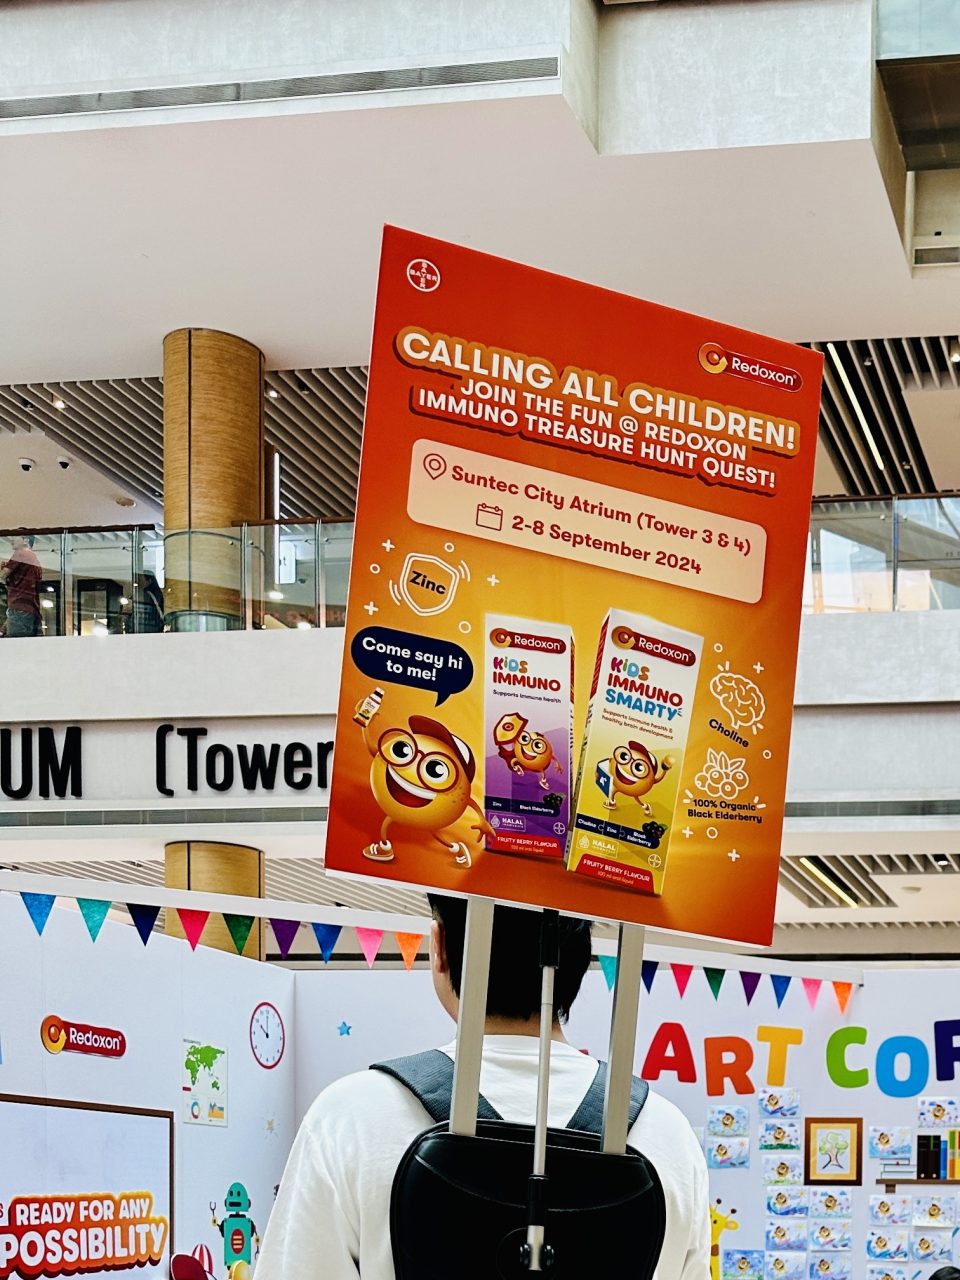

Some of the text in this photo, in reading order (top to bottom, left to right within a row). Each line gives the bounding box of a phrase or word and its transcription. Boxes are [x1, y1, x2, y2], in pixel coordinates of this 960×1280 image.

[409, 268, 438, 282] BAYER
[732, 357, 795, 386] Redoxon
[403, 332, 795, 450] CALLING ALL CHILDREN!
[461, 379, 746, 460] JOIN THE FUN @ REDOXON
[419, 388, 775, 488] IMMUNO TREASURE HUNT QUEST!
[452, 465, 751, 557] Suntec City Atrium (Tower 3 & 4)
[512, 515, 702, 574] 2-8 September 2024
[410, 570, 446, 595] Zinc
[362, 636, 463, 670] Come say hi
[514, 635, 560, 650] Redoxon
[638, 637, 690, 662] Redoxon
[386, 660, 437, 681] to me!
[492, 671, 562, 692] IMMUNO
[608, 672, 684, 707] IMMUNO
[605, 688, 678, 721] SMARTY
[708, 718, 750, 748] Choline
[0, 724, 335, 798] UM (Tower
[688, 809, 762, 824] Black Elderberry
[693, 798, 756, 812] 100% Organic
[502, 817, 523, 825] HALAL
[592, 840, 616, 850] HALAL
[583, 859, 604, 869] FRUITY
[624, 870, 650, 882] FLAVOUR
[69, 1027, 120, 1050] Redoxon
[641, 1022, 803, 1097] ART
[16, 1198, 150, 1226] READY FOR ANY
[0, 1222, 165, 1268] POSSIBILITY
